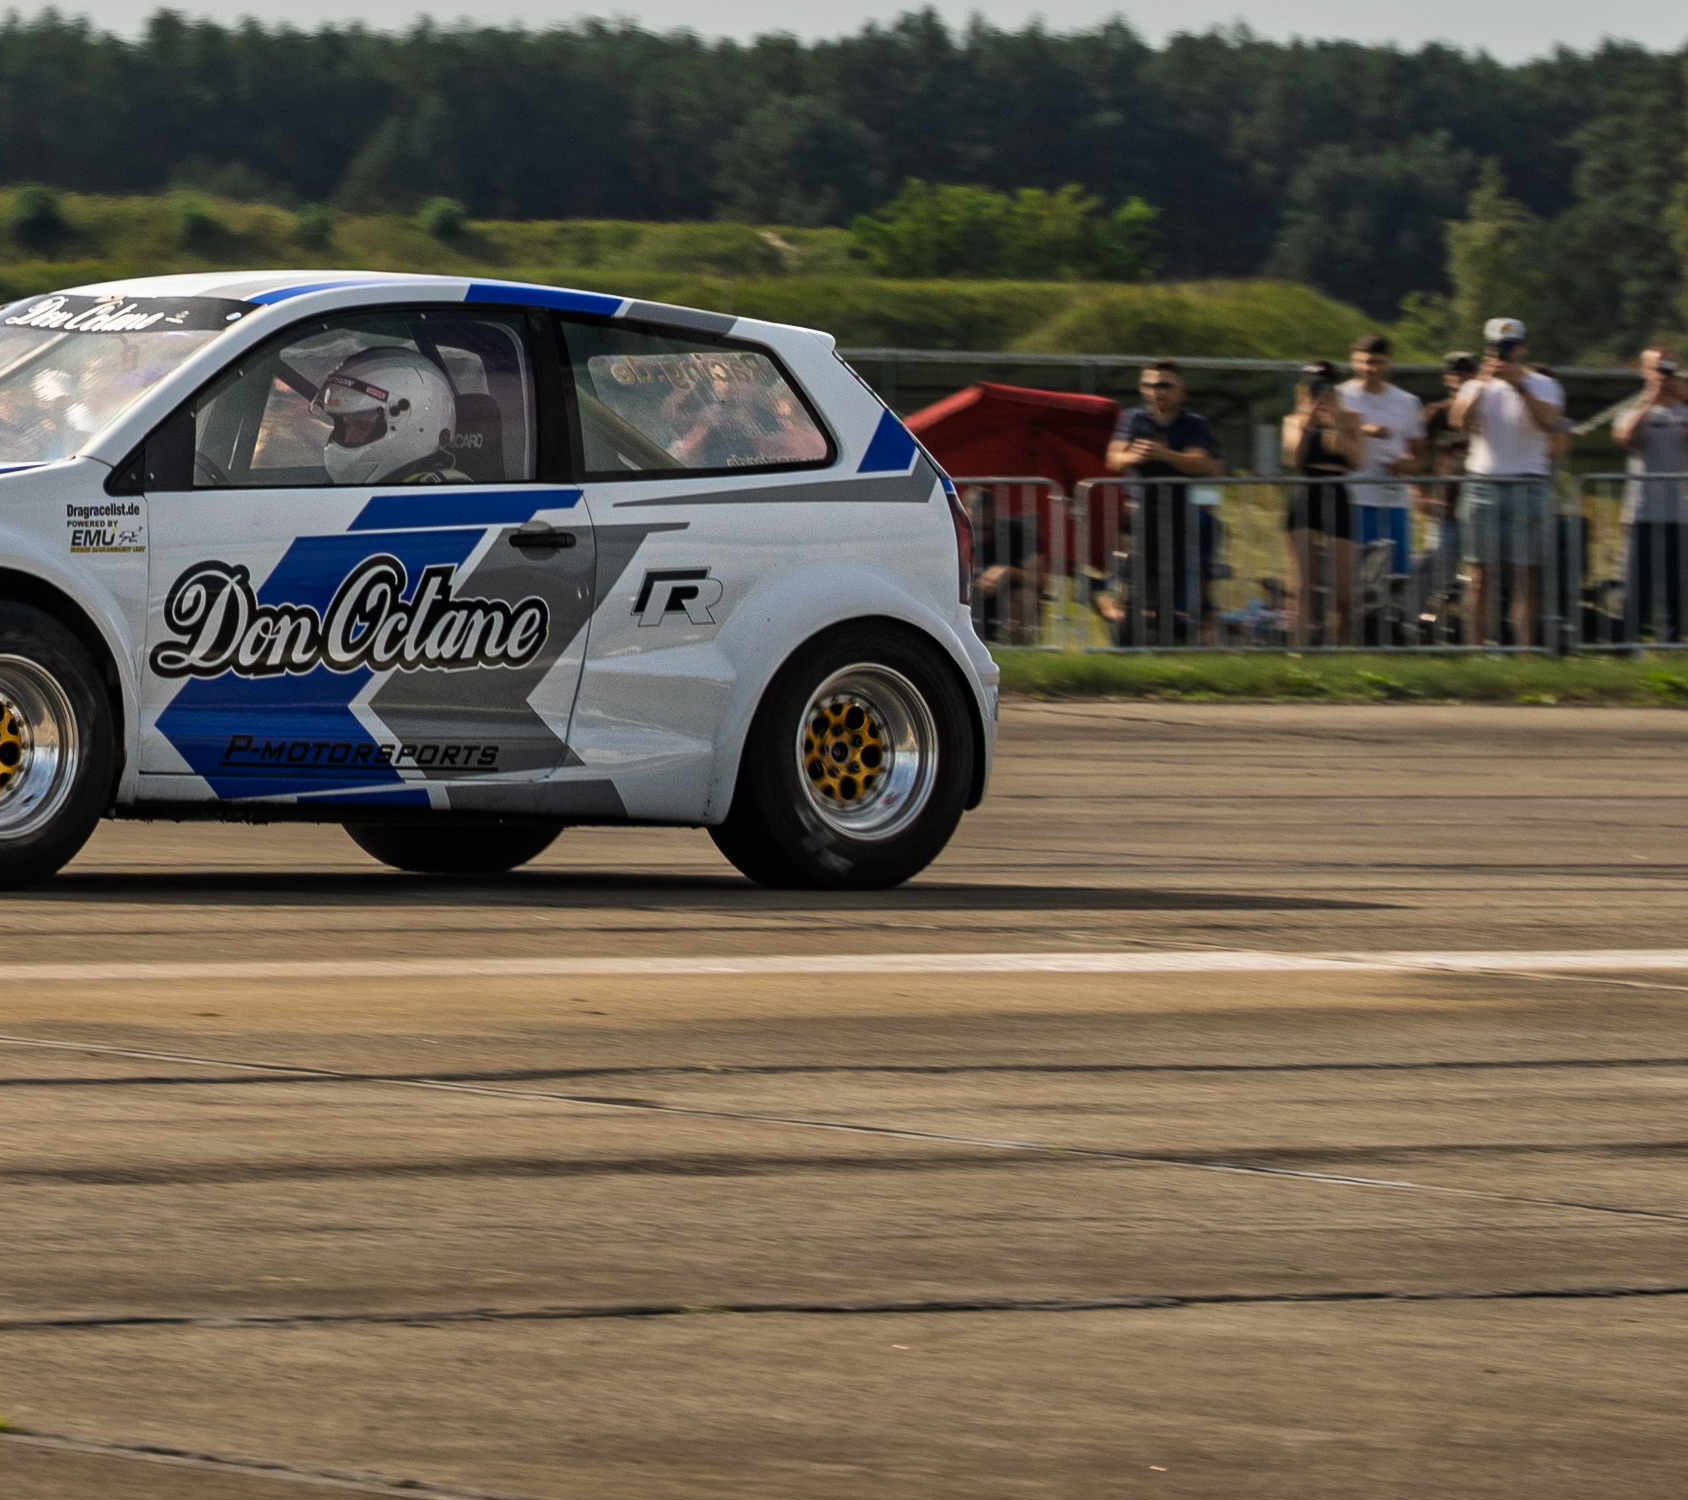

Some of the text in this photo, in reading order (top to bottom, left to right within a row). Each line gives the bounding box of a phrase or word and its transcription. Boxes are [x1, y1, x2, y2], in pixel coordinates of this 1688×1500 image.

[6, 296, 74, 328] Don
[452, 433, 484, 449] CARO
[67, 503, 140, 519] Dragracelist.de
[71, 529, 115, 546] EMU
[149, 553, 550, 680] Don Octane
[223, 735, 500, 765] P-MOTORSPORTS
